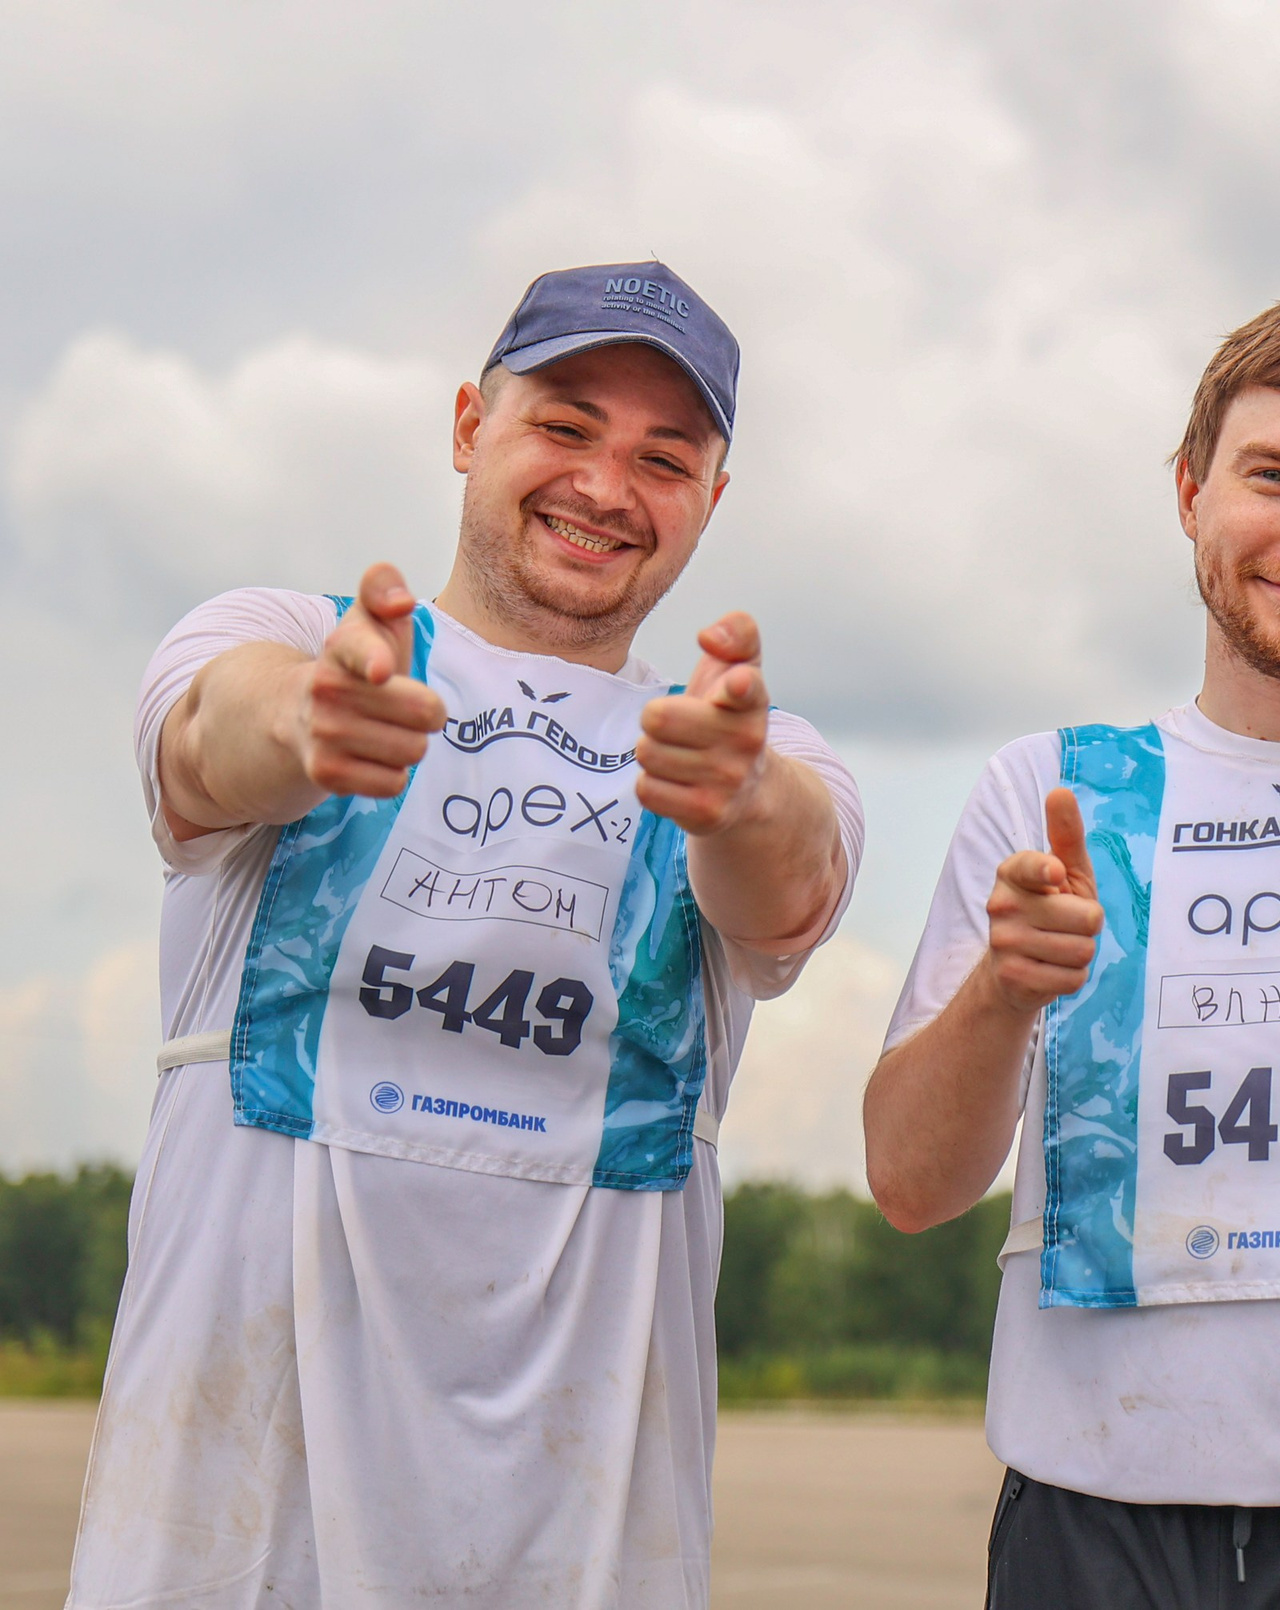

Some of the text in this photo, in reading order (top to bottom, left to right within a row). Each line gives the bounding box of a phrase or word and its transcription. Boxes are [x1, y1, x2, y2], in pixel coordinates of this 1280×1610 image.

[601, 301, 631, 312] activity
[642, 307, 656, 317] the
[657, 313, 686, 335] intellect
[603, 294, 634, 303] relating
[645, 301, 672, 316] mental
[604, 278, 690, 318] NOETIC
[527, 711, 638, 768] ГЕРОЕВ
[442, 785, 619, 847] apex
[358, 944, 594, 1056] 5449
[411, 1095, 547, 1133] ГАЗПРОМБАНК
